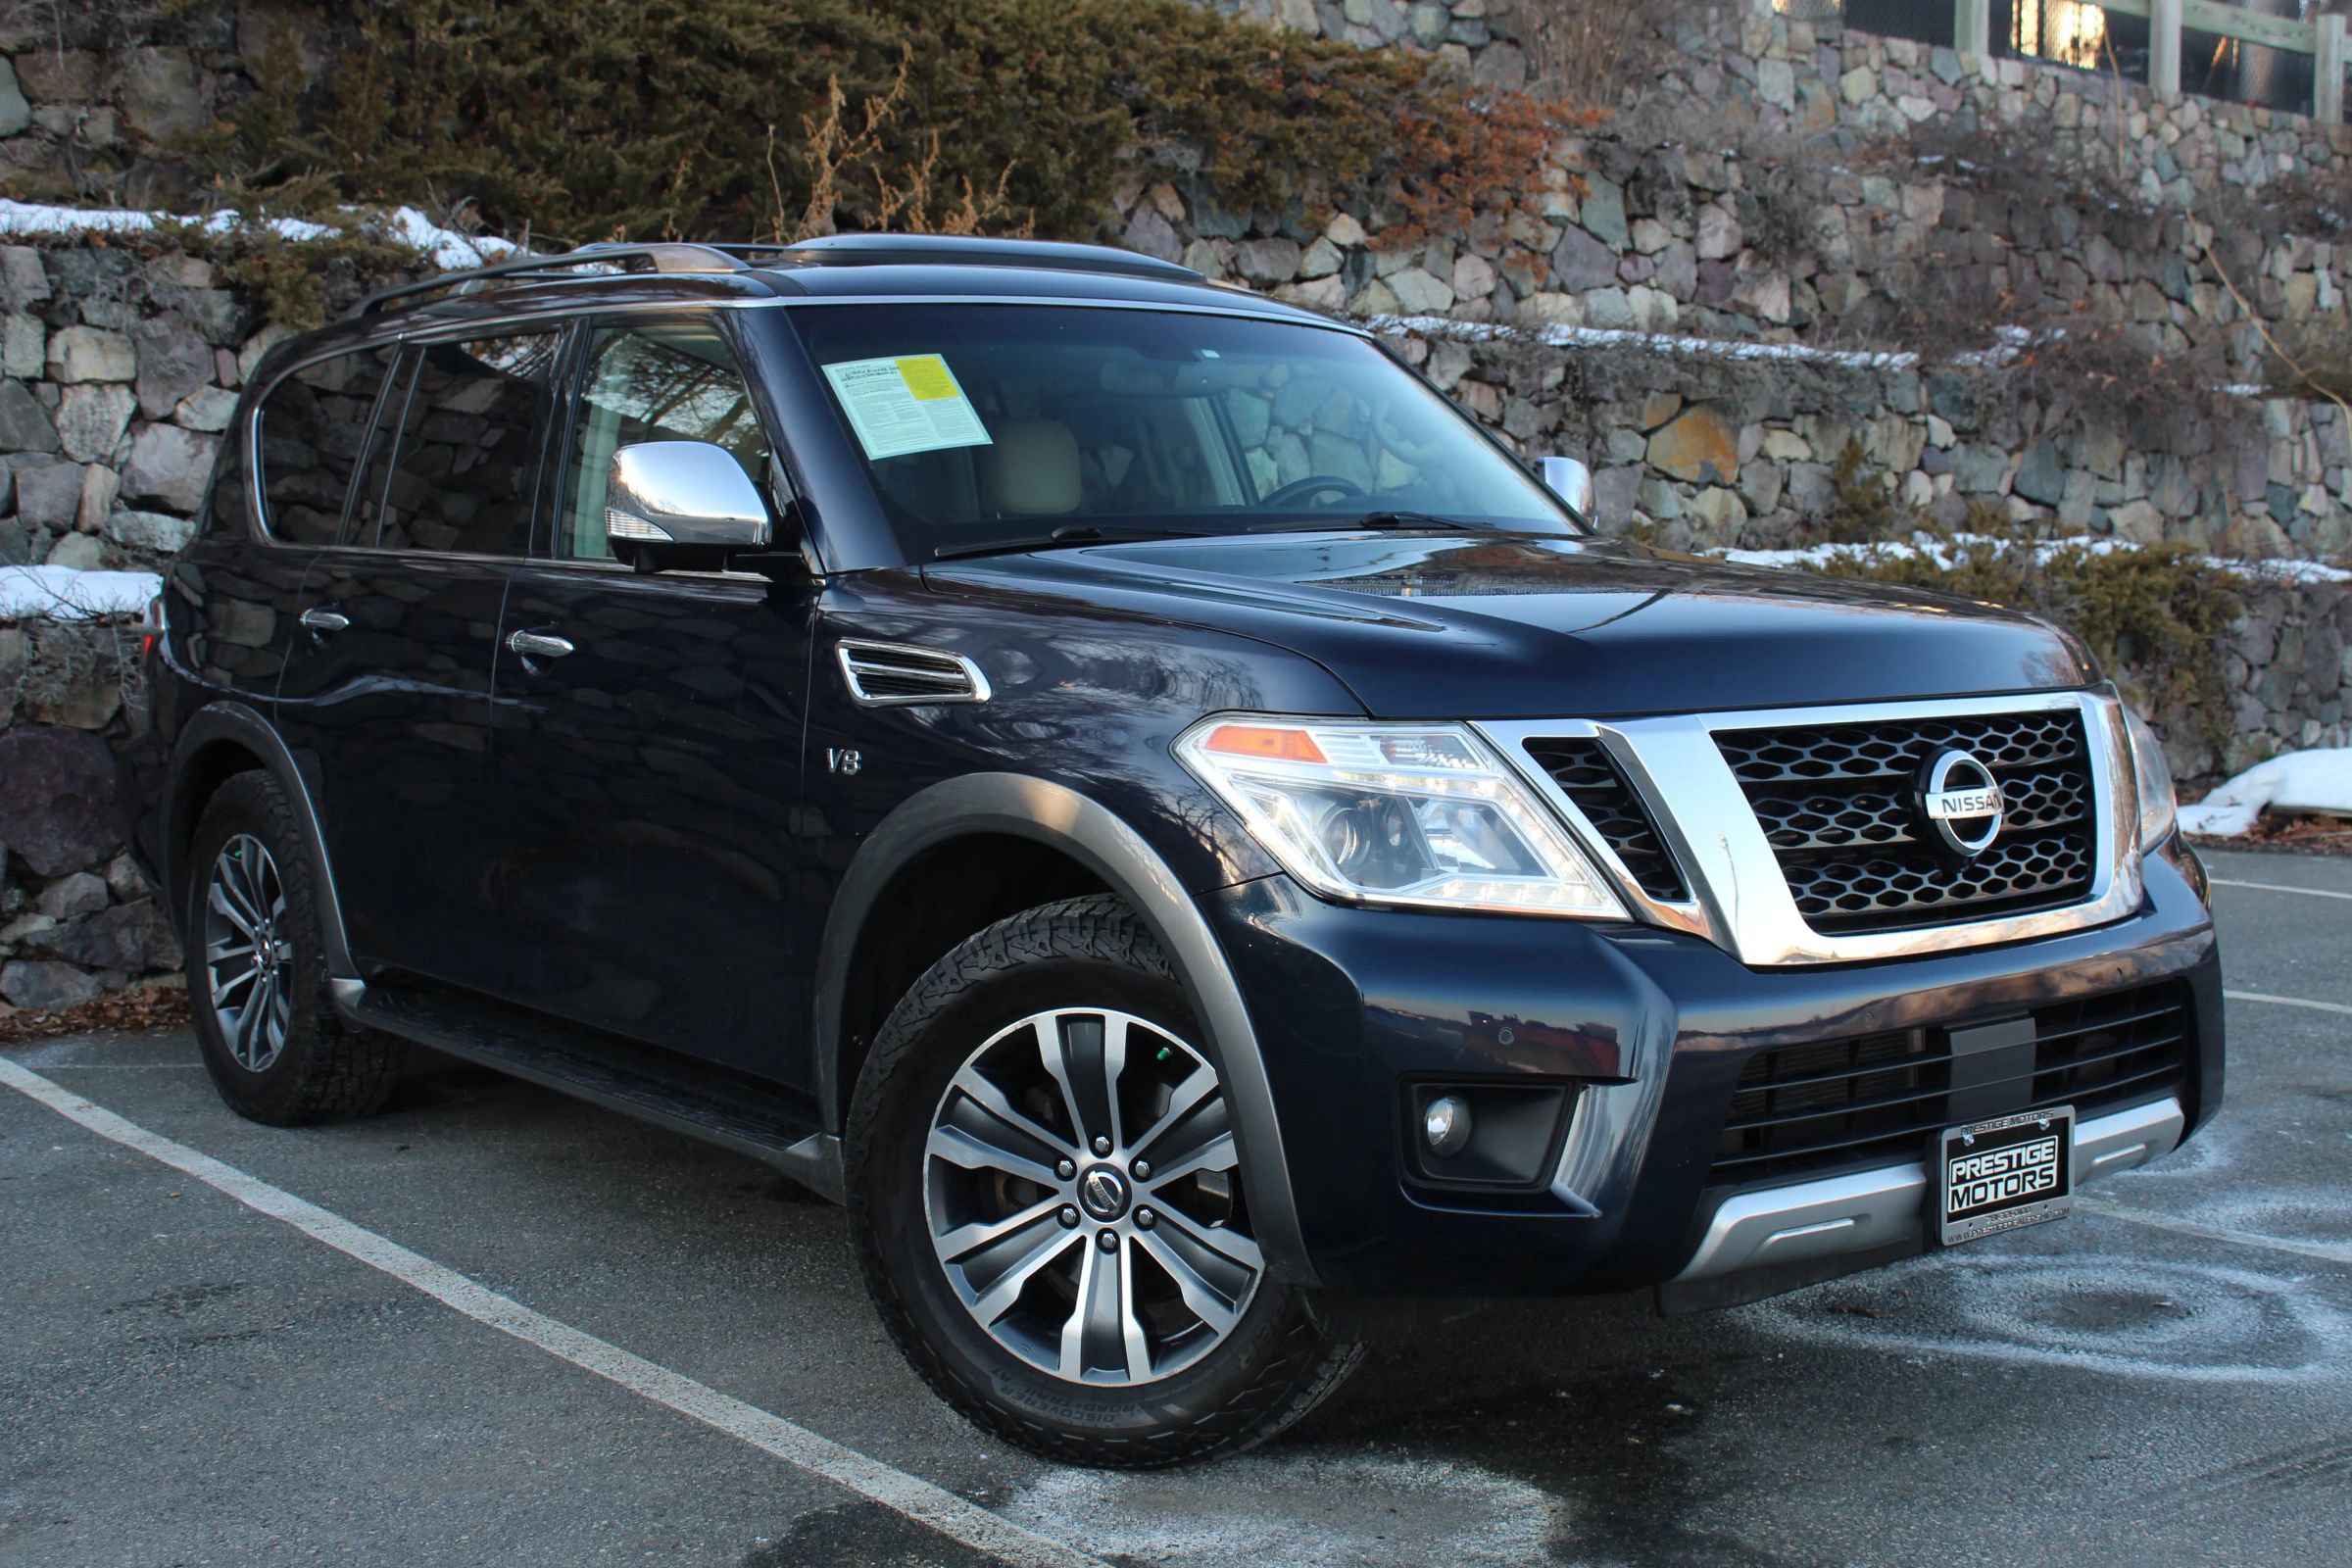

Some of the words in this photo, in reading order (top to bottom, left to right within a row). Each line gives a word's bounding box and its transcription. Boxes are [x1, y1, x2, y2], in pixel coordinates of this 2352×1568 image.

[826, 748, 861, 775] V8
[1941, 793, 2003, 813] NISSAN
[1961, 1118, 2008, 1135] PRESTIGE
[2010, 1110, 2054, 1127] MOTORS
[1951, 1140, 2055, 1184] PRESTIGE
[1951, 1165, 2054, 1210] MOTORS
[1000, 1384, 1115, 1423] DISCOVERER
